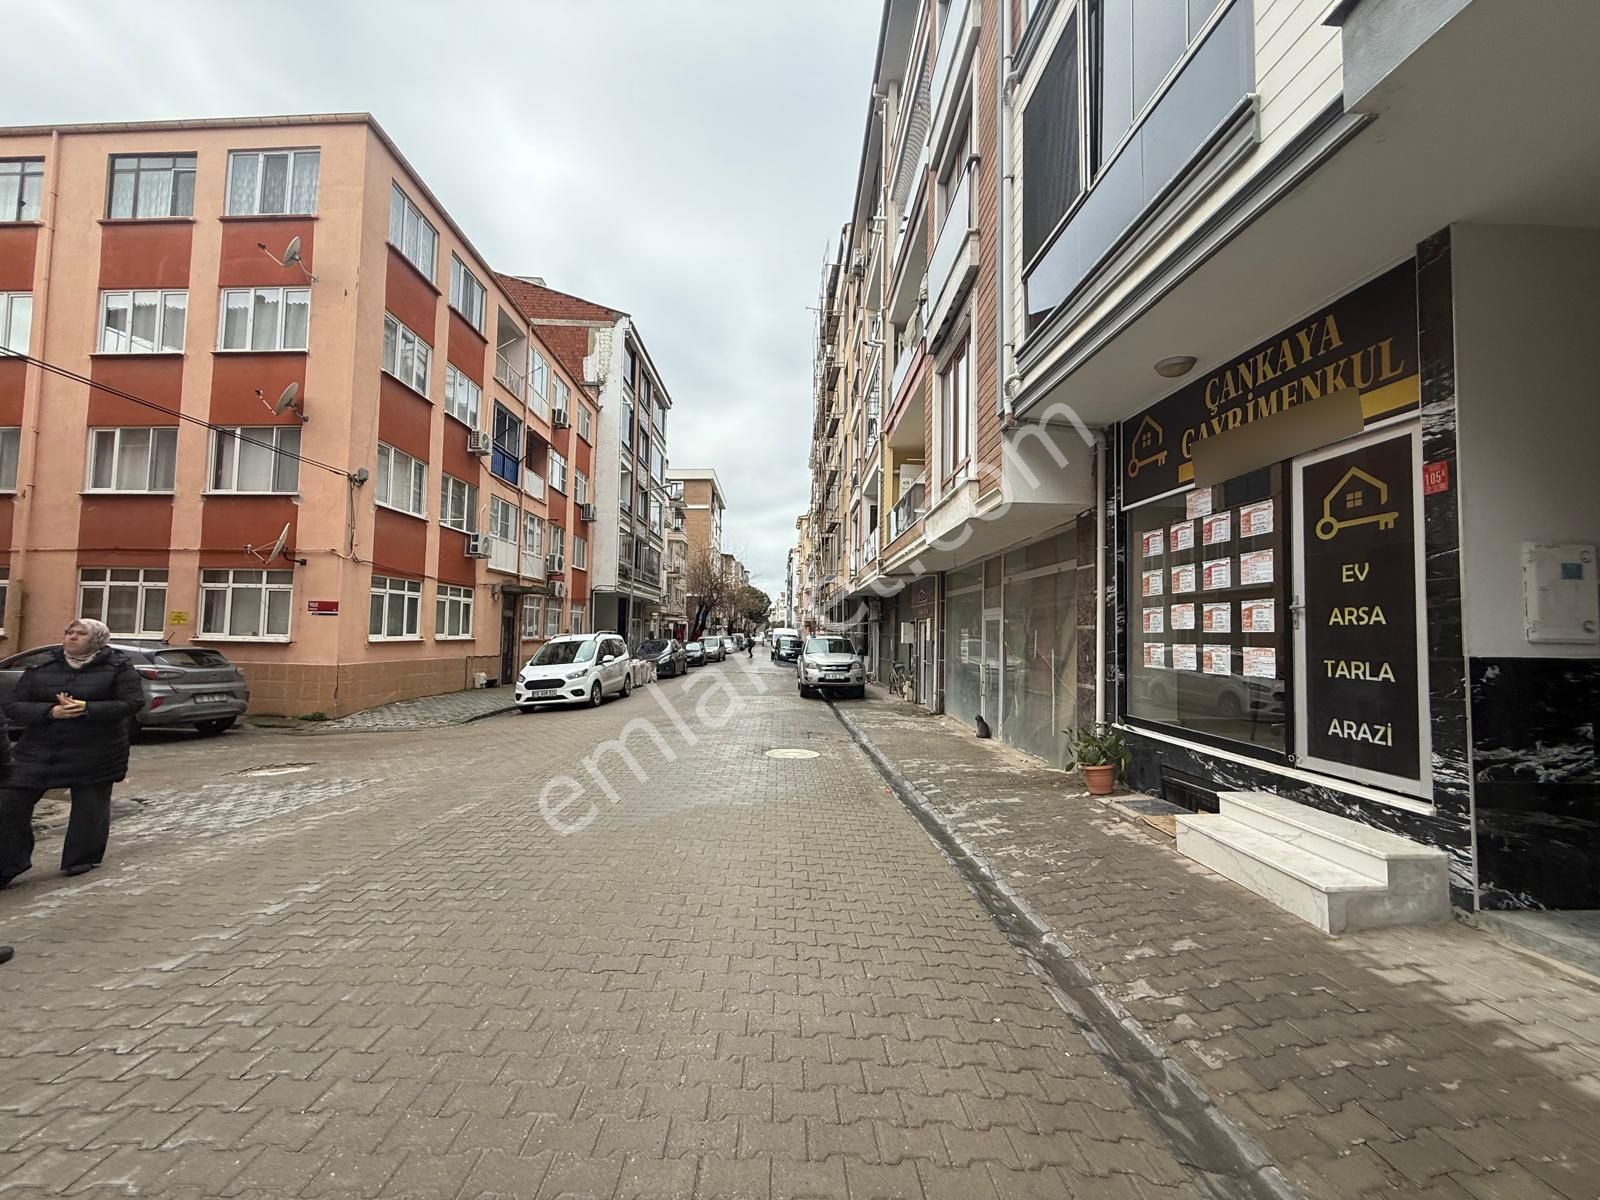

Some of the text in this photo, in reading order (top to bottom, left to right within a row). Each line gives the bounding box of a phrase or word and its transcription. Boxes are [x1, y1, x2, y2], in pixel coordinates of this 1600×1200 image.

[1205, 314, 1343, 416] ÇANKAYA
[1342, 562, 1369, 582] EV
[1328, 606, 1387, 626] ARSA
[1323, 659, 1396, 682] TARLA
[1327, 718, 1393, 747] ARAZİ
